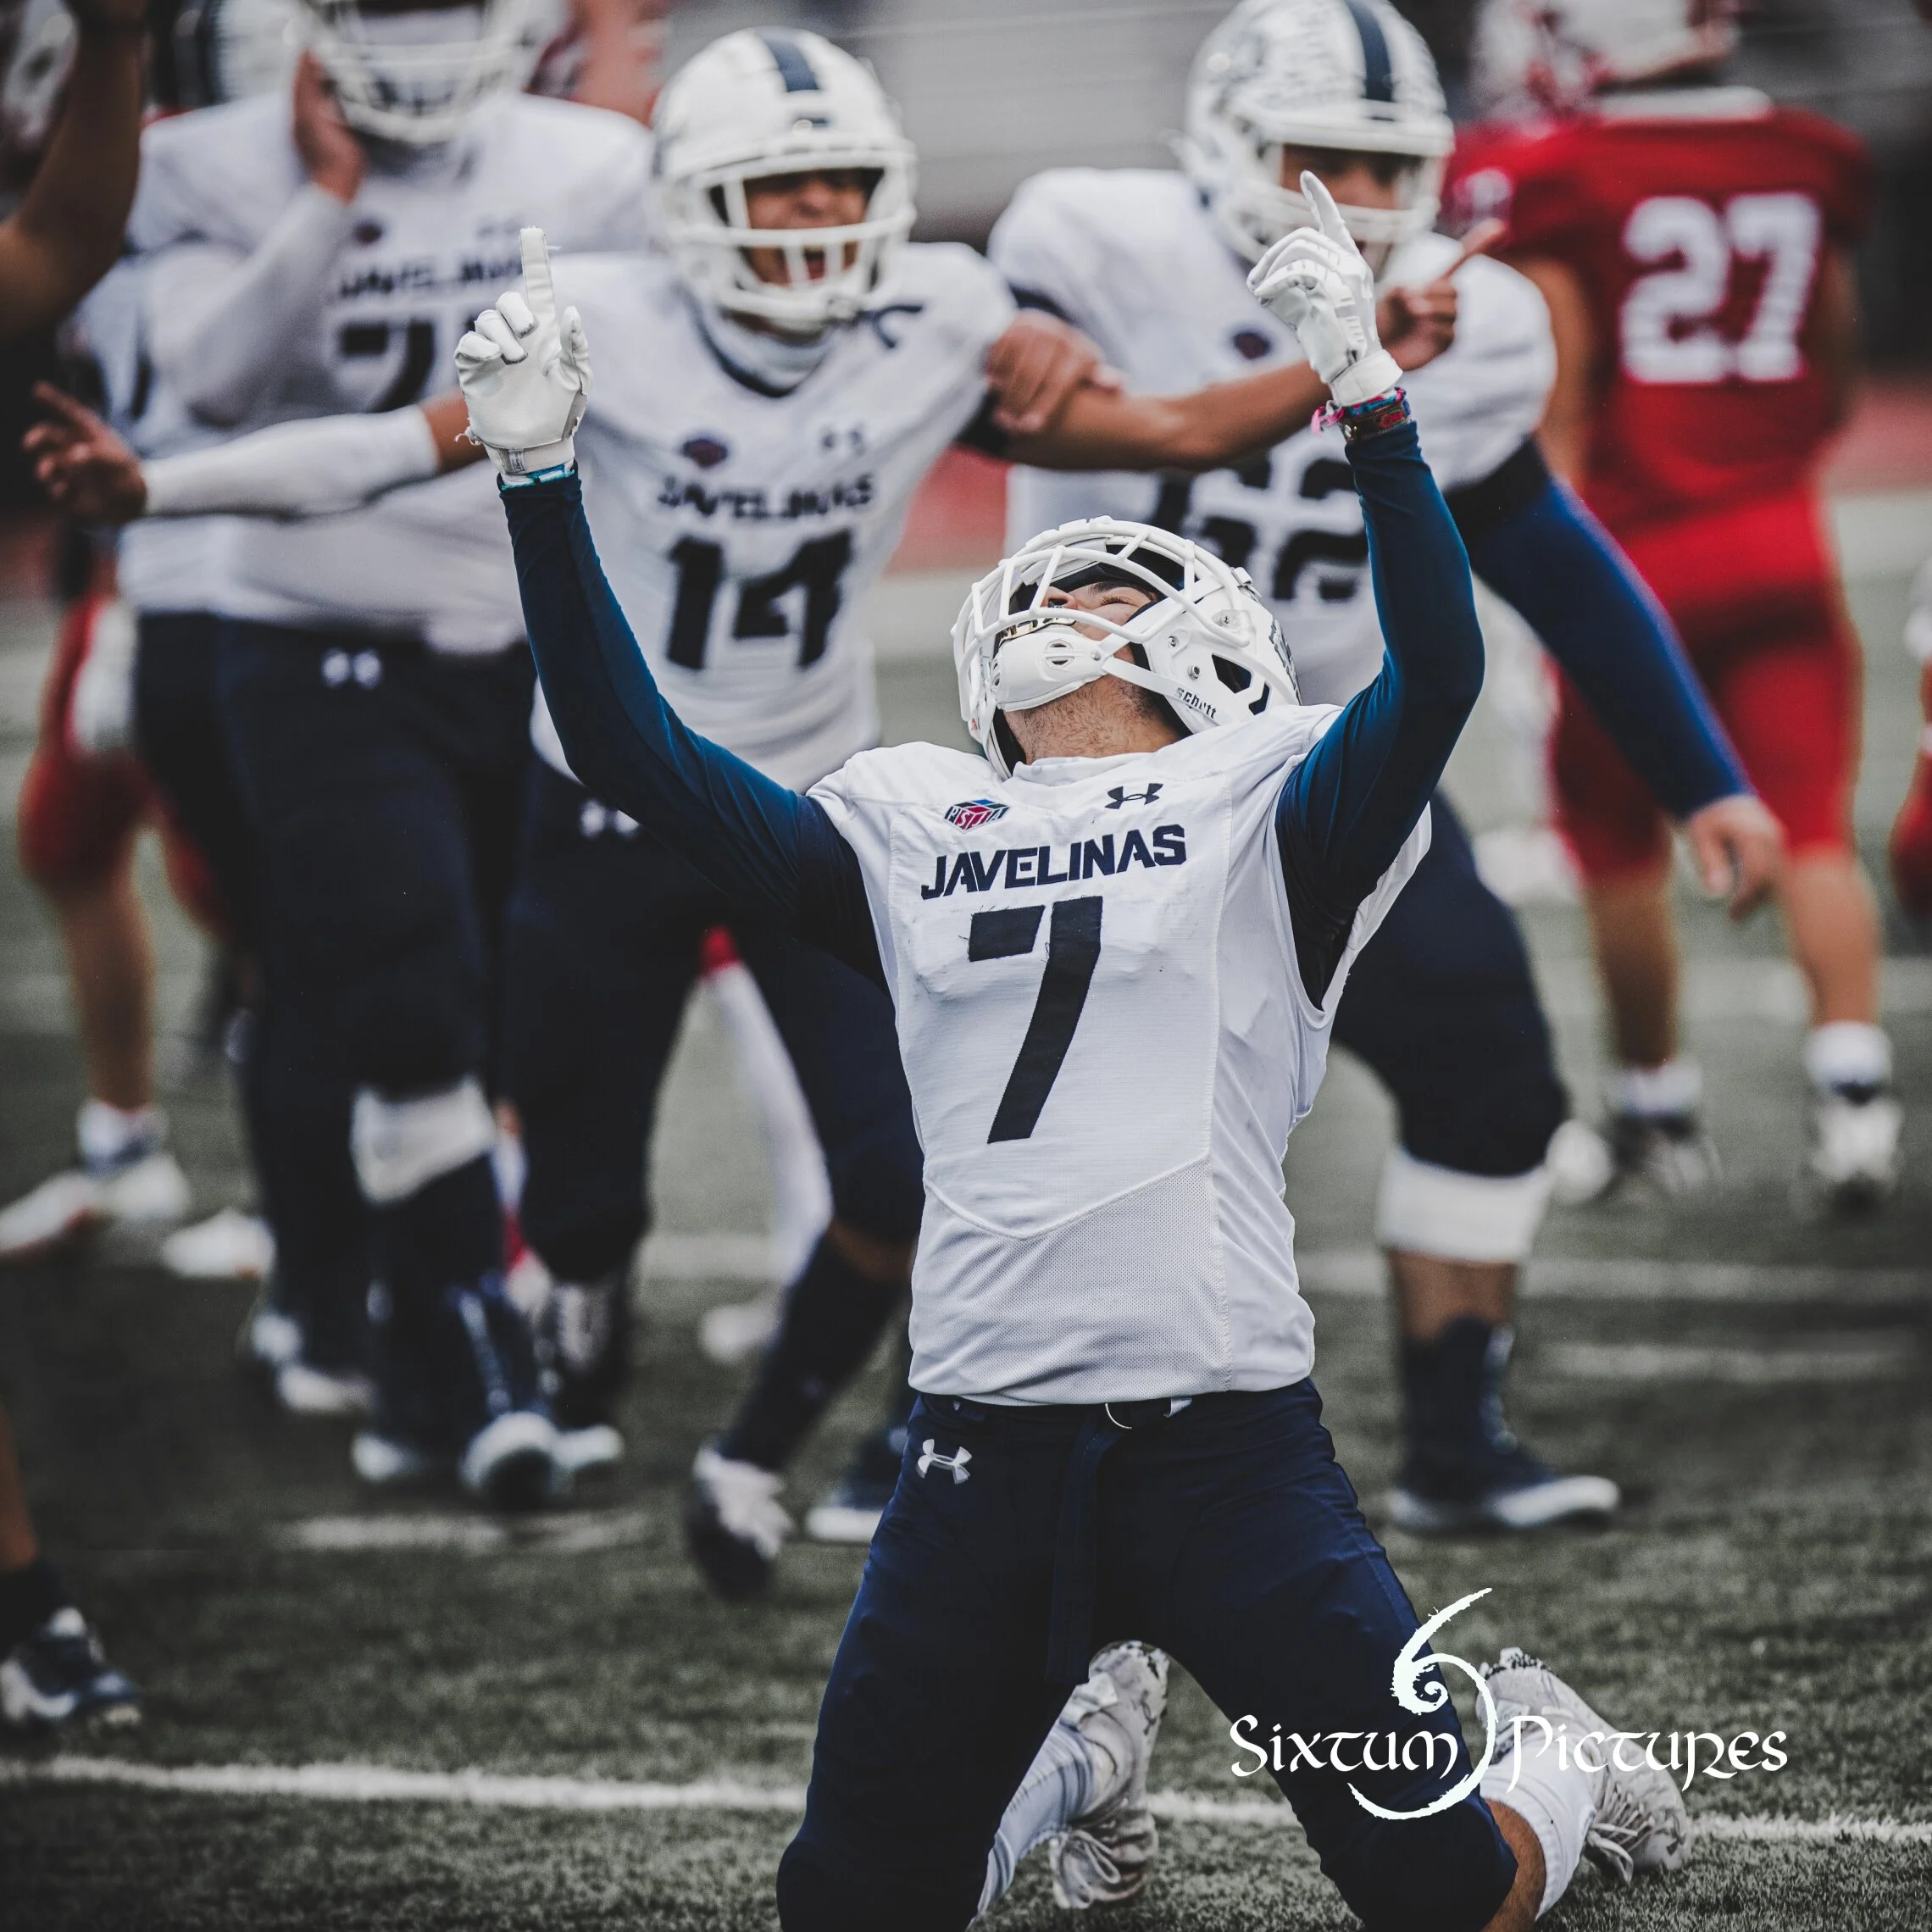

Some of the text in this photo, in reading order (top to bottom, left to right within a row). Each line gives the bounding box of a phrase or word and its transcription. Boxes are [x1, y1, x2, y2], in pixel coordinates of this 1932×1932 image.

[1619, 190, 1822, 383] 27
[667, 528, 852, 669] 14
[921, 824, 1187, 900] JAVELINAS
[944, 804, 1008, 830] PSJA
[968, 896, 1103, 1144] 7
